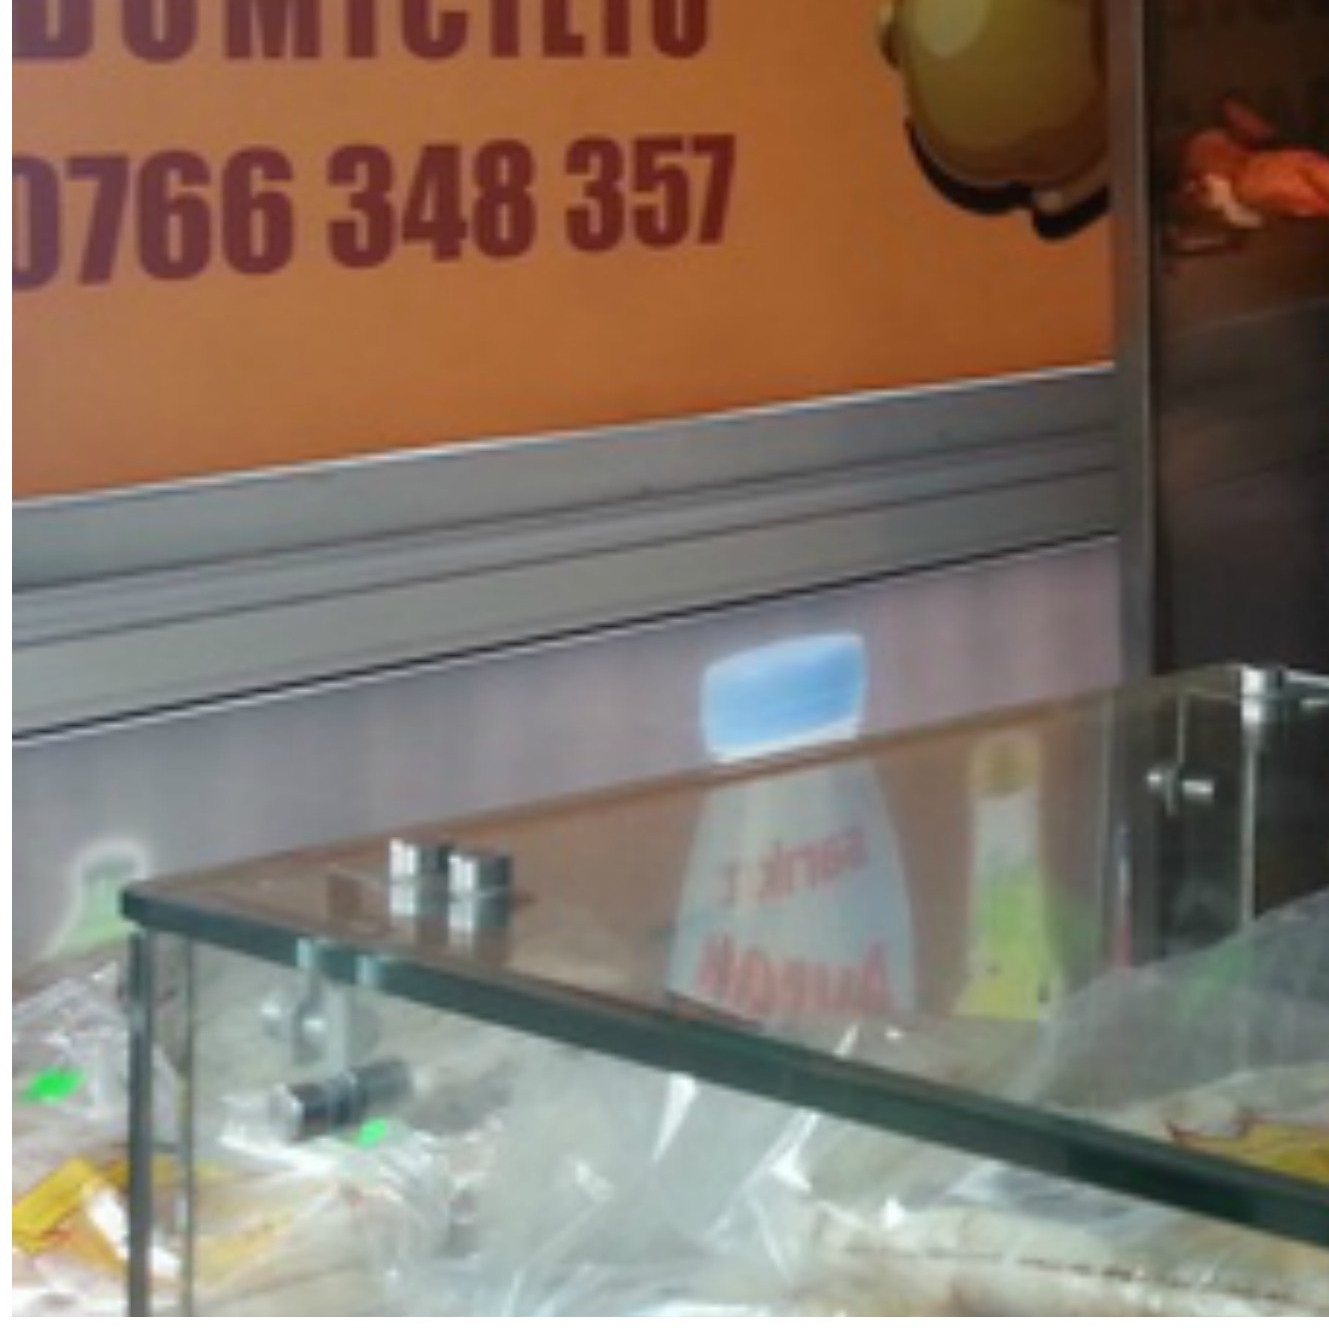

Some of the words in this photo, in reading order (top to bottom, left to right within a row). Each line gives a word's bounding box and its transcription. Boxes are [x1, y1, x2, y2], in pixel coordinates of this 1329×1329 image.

[12, 147, 293, 291] 0766
[326, 140, 537, 270] 348
[564, 134, 737, 253] 357
